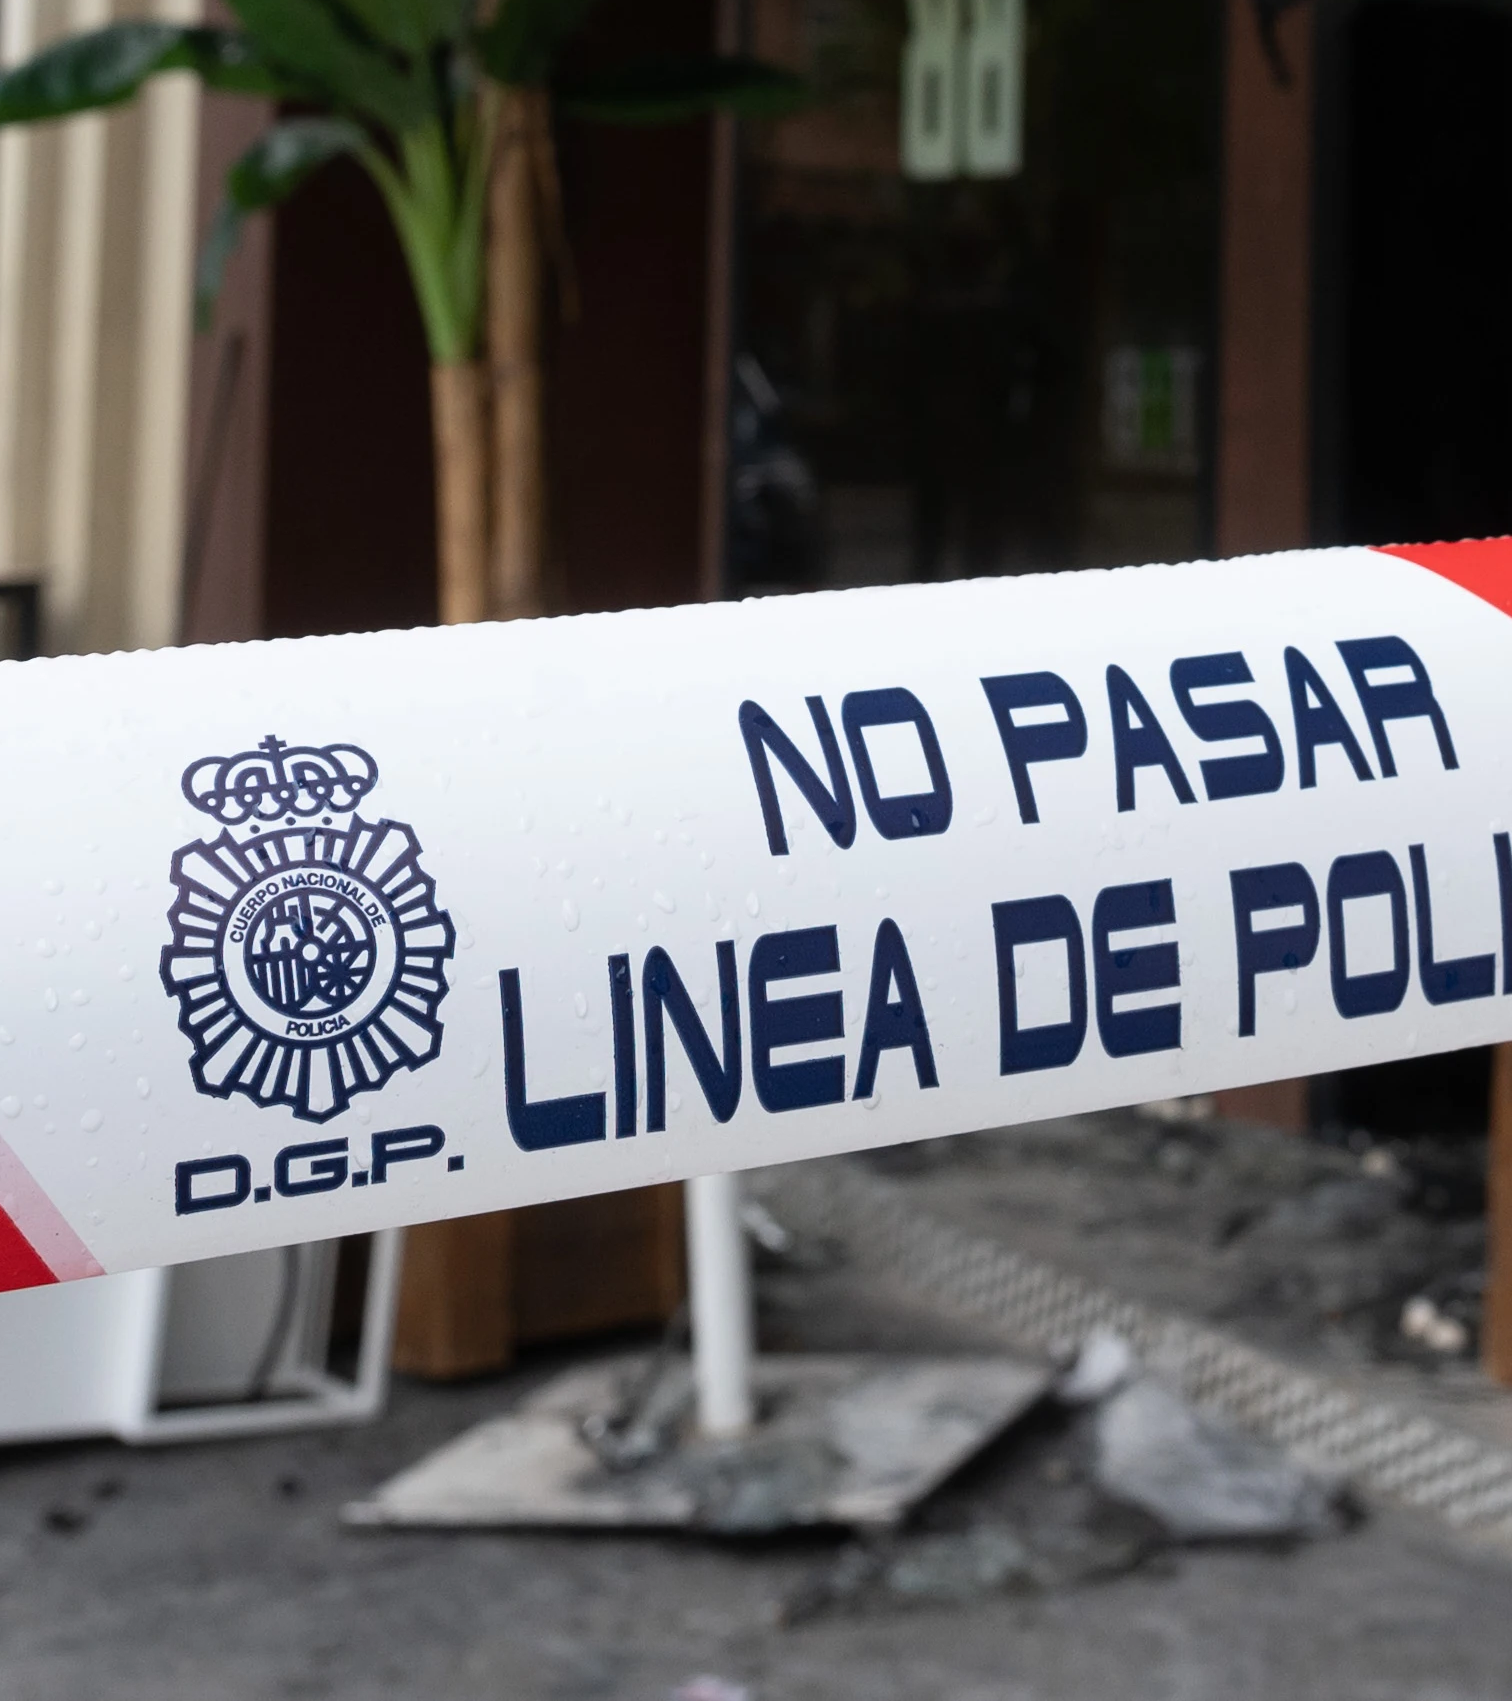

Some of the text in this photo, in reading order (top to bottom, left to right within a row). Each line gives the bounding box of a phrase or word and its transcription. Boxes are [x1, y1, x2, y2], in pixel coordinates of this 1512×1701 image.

[736, 635, 1459, 856] NO PASAR
[229, 872, 387, 944] CUERPO NACIONAL DE
[285, 1014, 350, 1037] POLICIA
[498, 918, 939, 1153] LINEA
[991, 878, 1182, 1076] DE
[175, 1124, 464, 1216] D.G.P.
